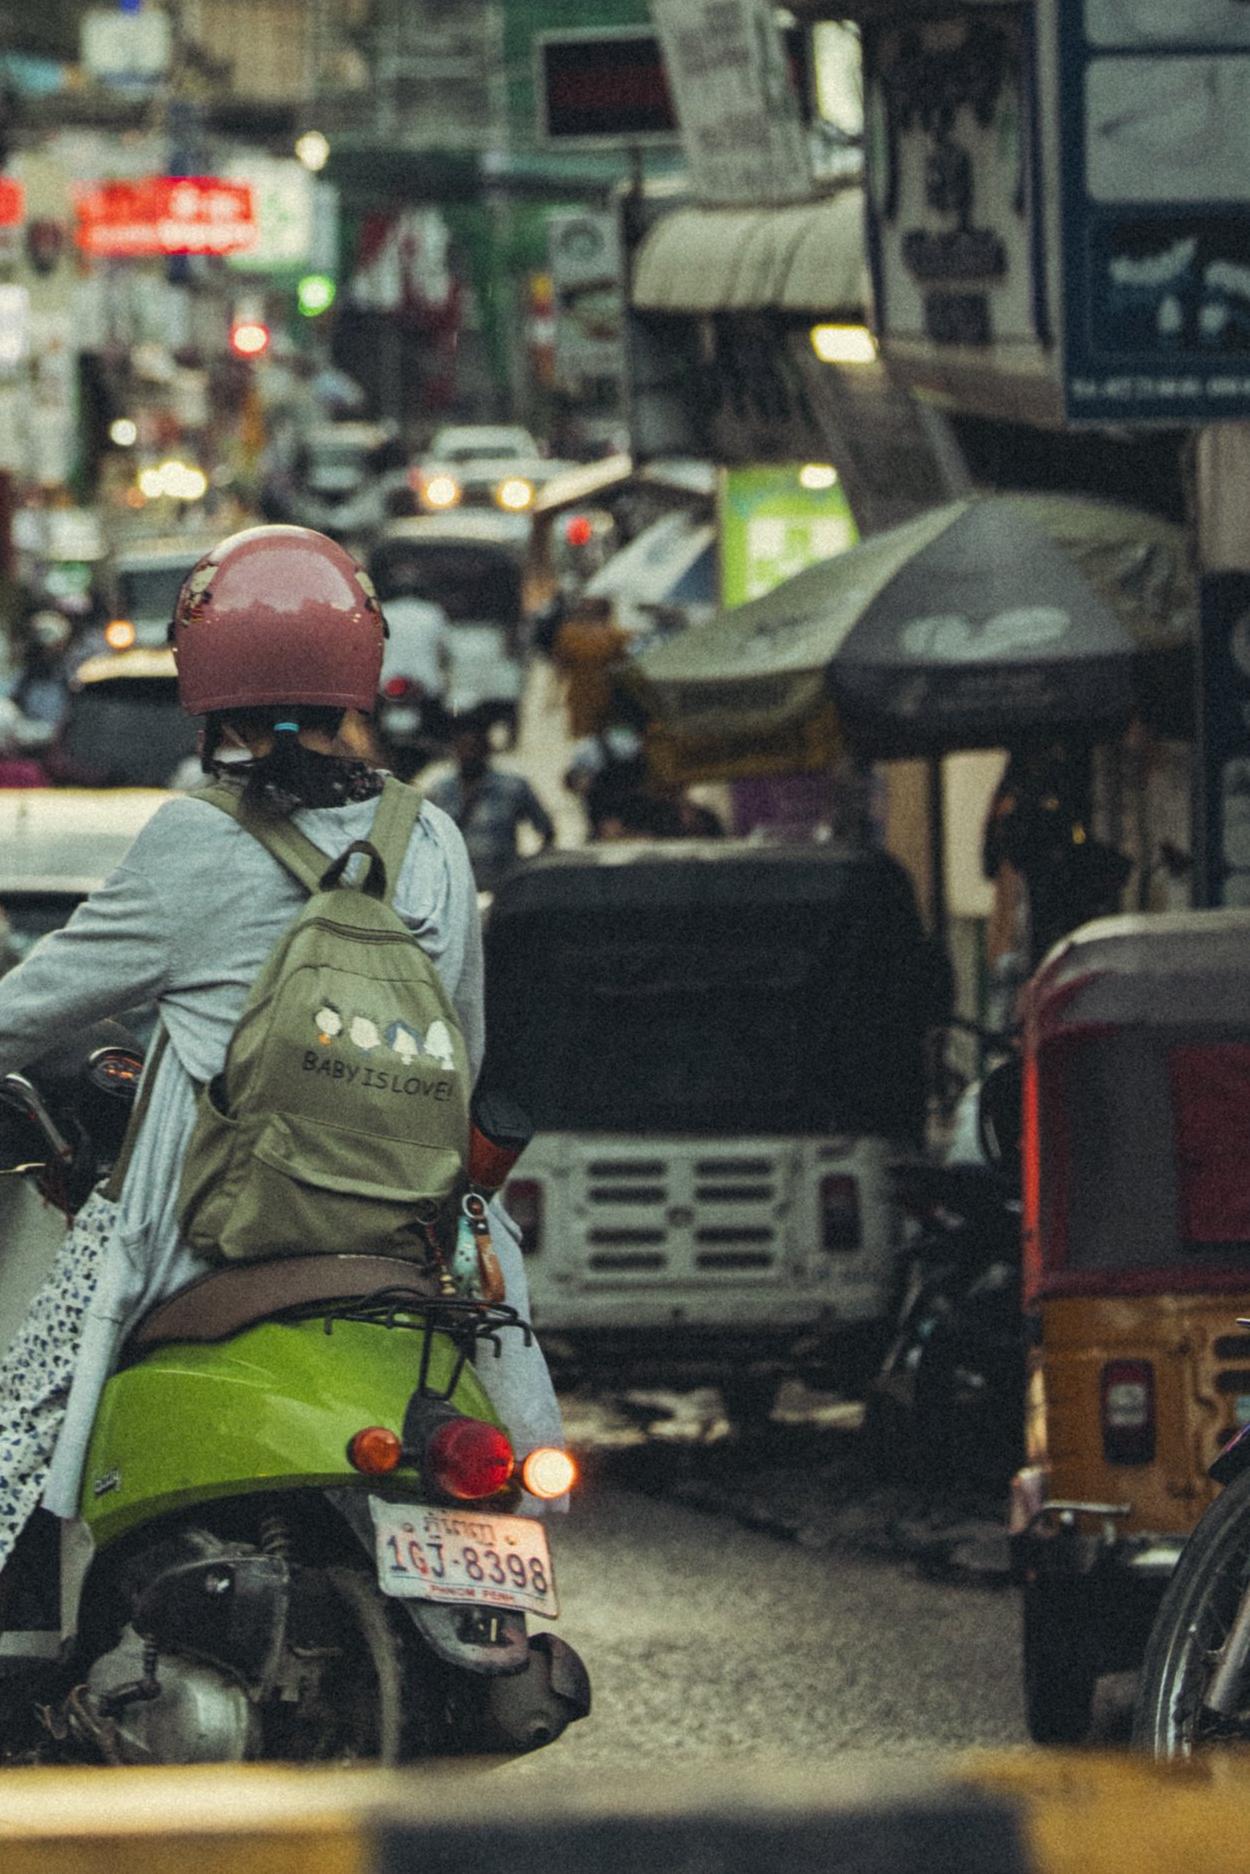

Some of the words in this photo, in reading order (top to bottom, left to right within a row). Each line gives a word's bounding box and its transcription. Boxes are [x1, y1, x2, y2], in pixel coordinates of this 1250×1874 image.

[302, 1051, 360, 1083] BABY
[361, 1068, 387, 1089] IS
[387, 1535, 548, 1595] 1GJ-8398
[430, 1585, 476, 1598] PHNOM
[482, 1589, 516, 1603] PENH
